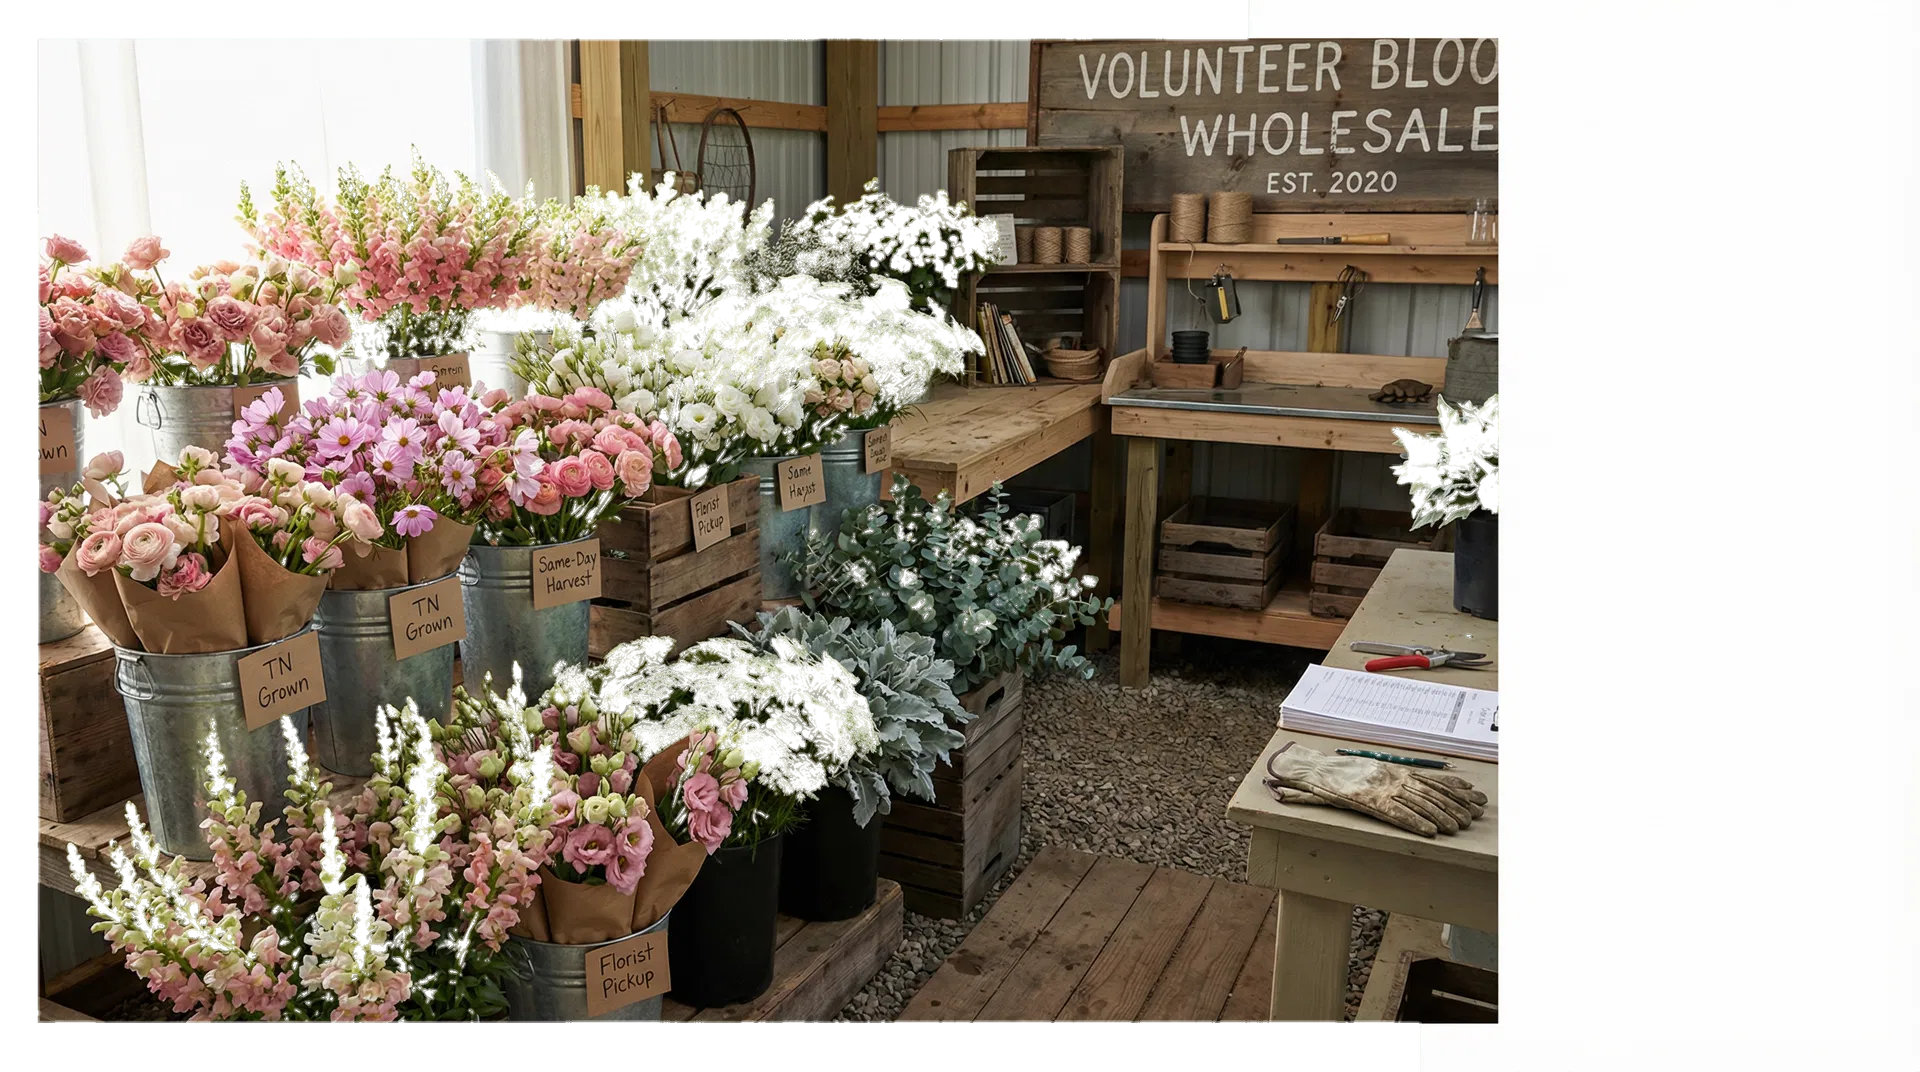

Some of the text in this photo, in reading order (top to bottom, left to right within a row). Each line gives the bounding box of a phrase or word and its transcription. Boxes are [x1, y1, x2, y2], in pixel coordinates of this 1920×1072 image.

[1079, 38, 1498, 99] VOLUNTEER BLOO
[1180, 105, 1498, 156] WHOLESALE
[1267, 170, 1397, 194] EST. 2020
[698, 515, 724, 536] Pickup
[538, 551, 597, 573] Same-Day
[546, 569, 592, 594] Harvest
[412, 594, 439, 616] TN
[406, 616, 453, 641] Grown
[262, 652, 292, 679] TN
[259, 677, 309, 708] Grown
[600, 942, 654, 976] Florist
[602, 970, 654, 998] Pickup
